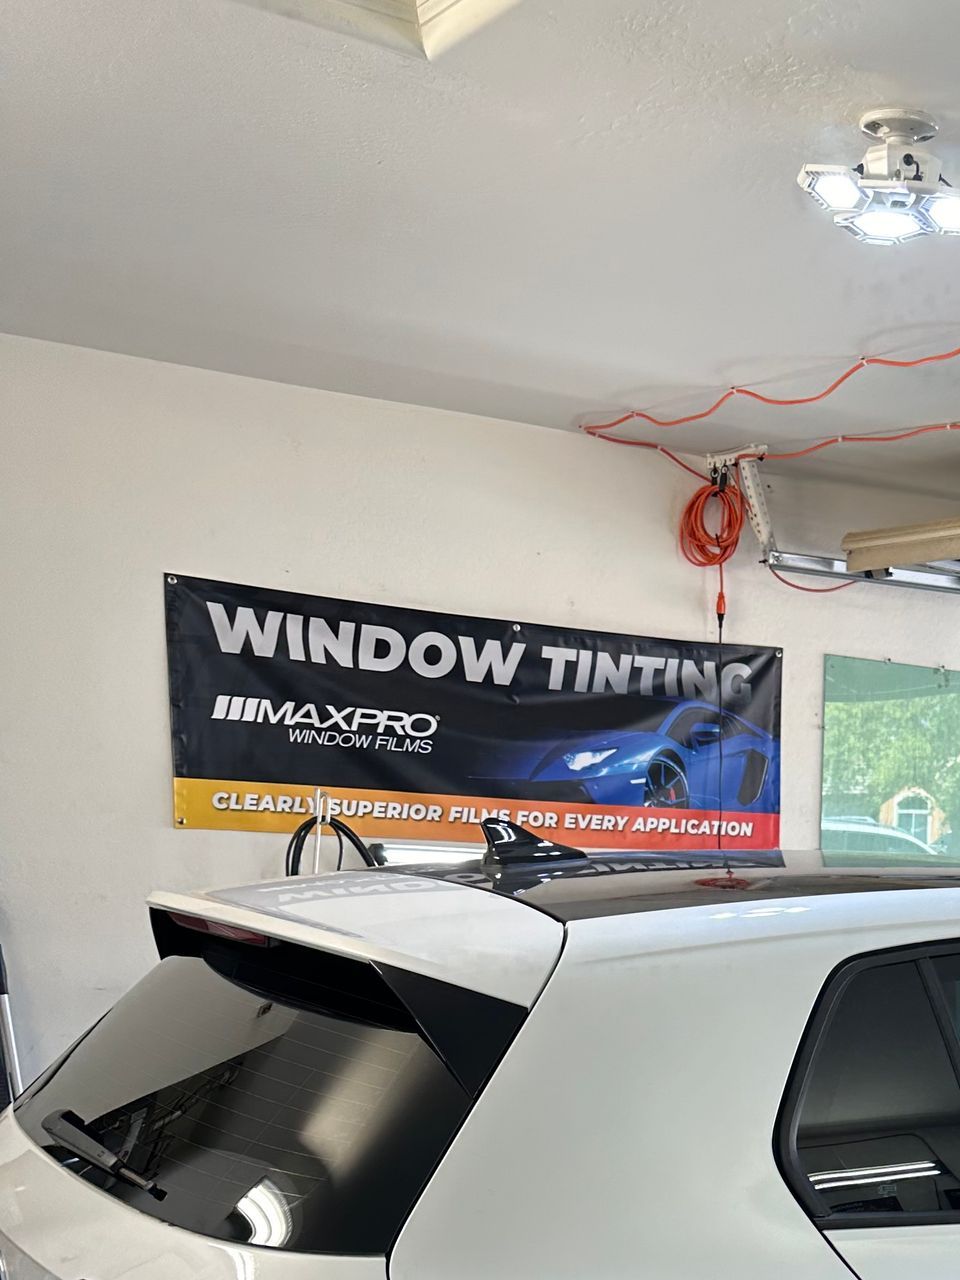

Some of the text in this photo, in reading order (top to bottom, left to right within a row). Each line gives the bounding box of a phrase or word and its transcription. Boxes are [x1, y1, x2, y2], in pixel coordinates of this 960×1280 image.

[206, 601, 752, 702] WINDOW TINTING
[257, 699, 438, 737] MAXPRO
[289, 728, 433, 754] WINDOW FILMS
[329, 799, 443, 822] SUPERIOR
[516, 811, 558, 829] FOR
[563, 813, 630, 832] EVERY
[631, 818, 753, 837] APPLICATION
